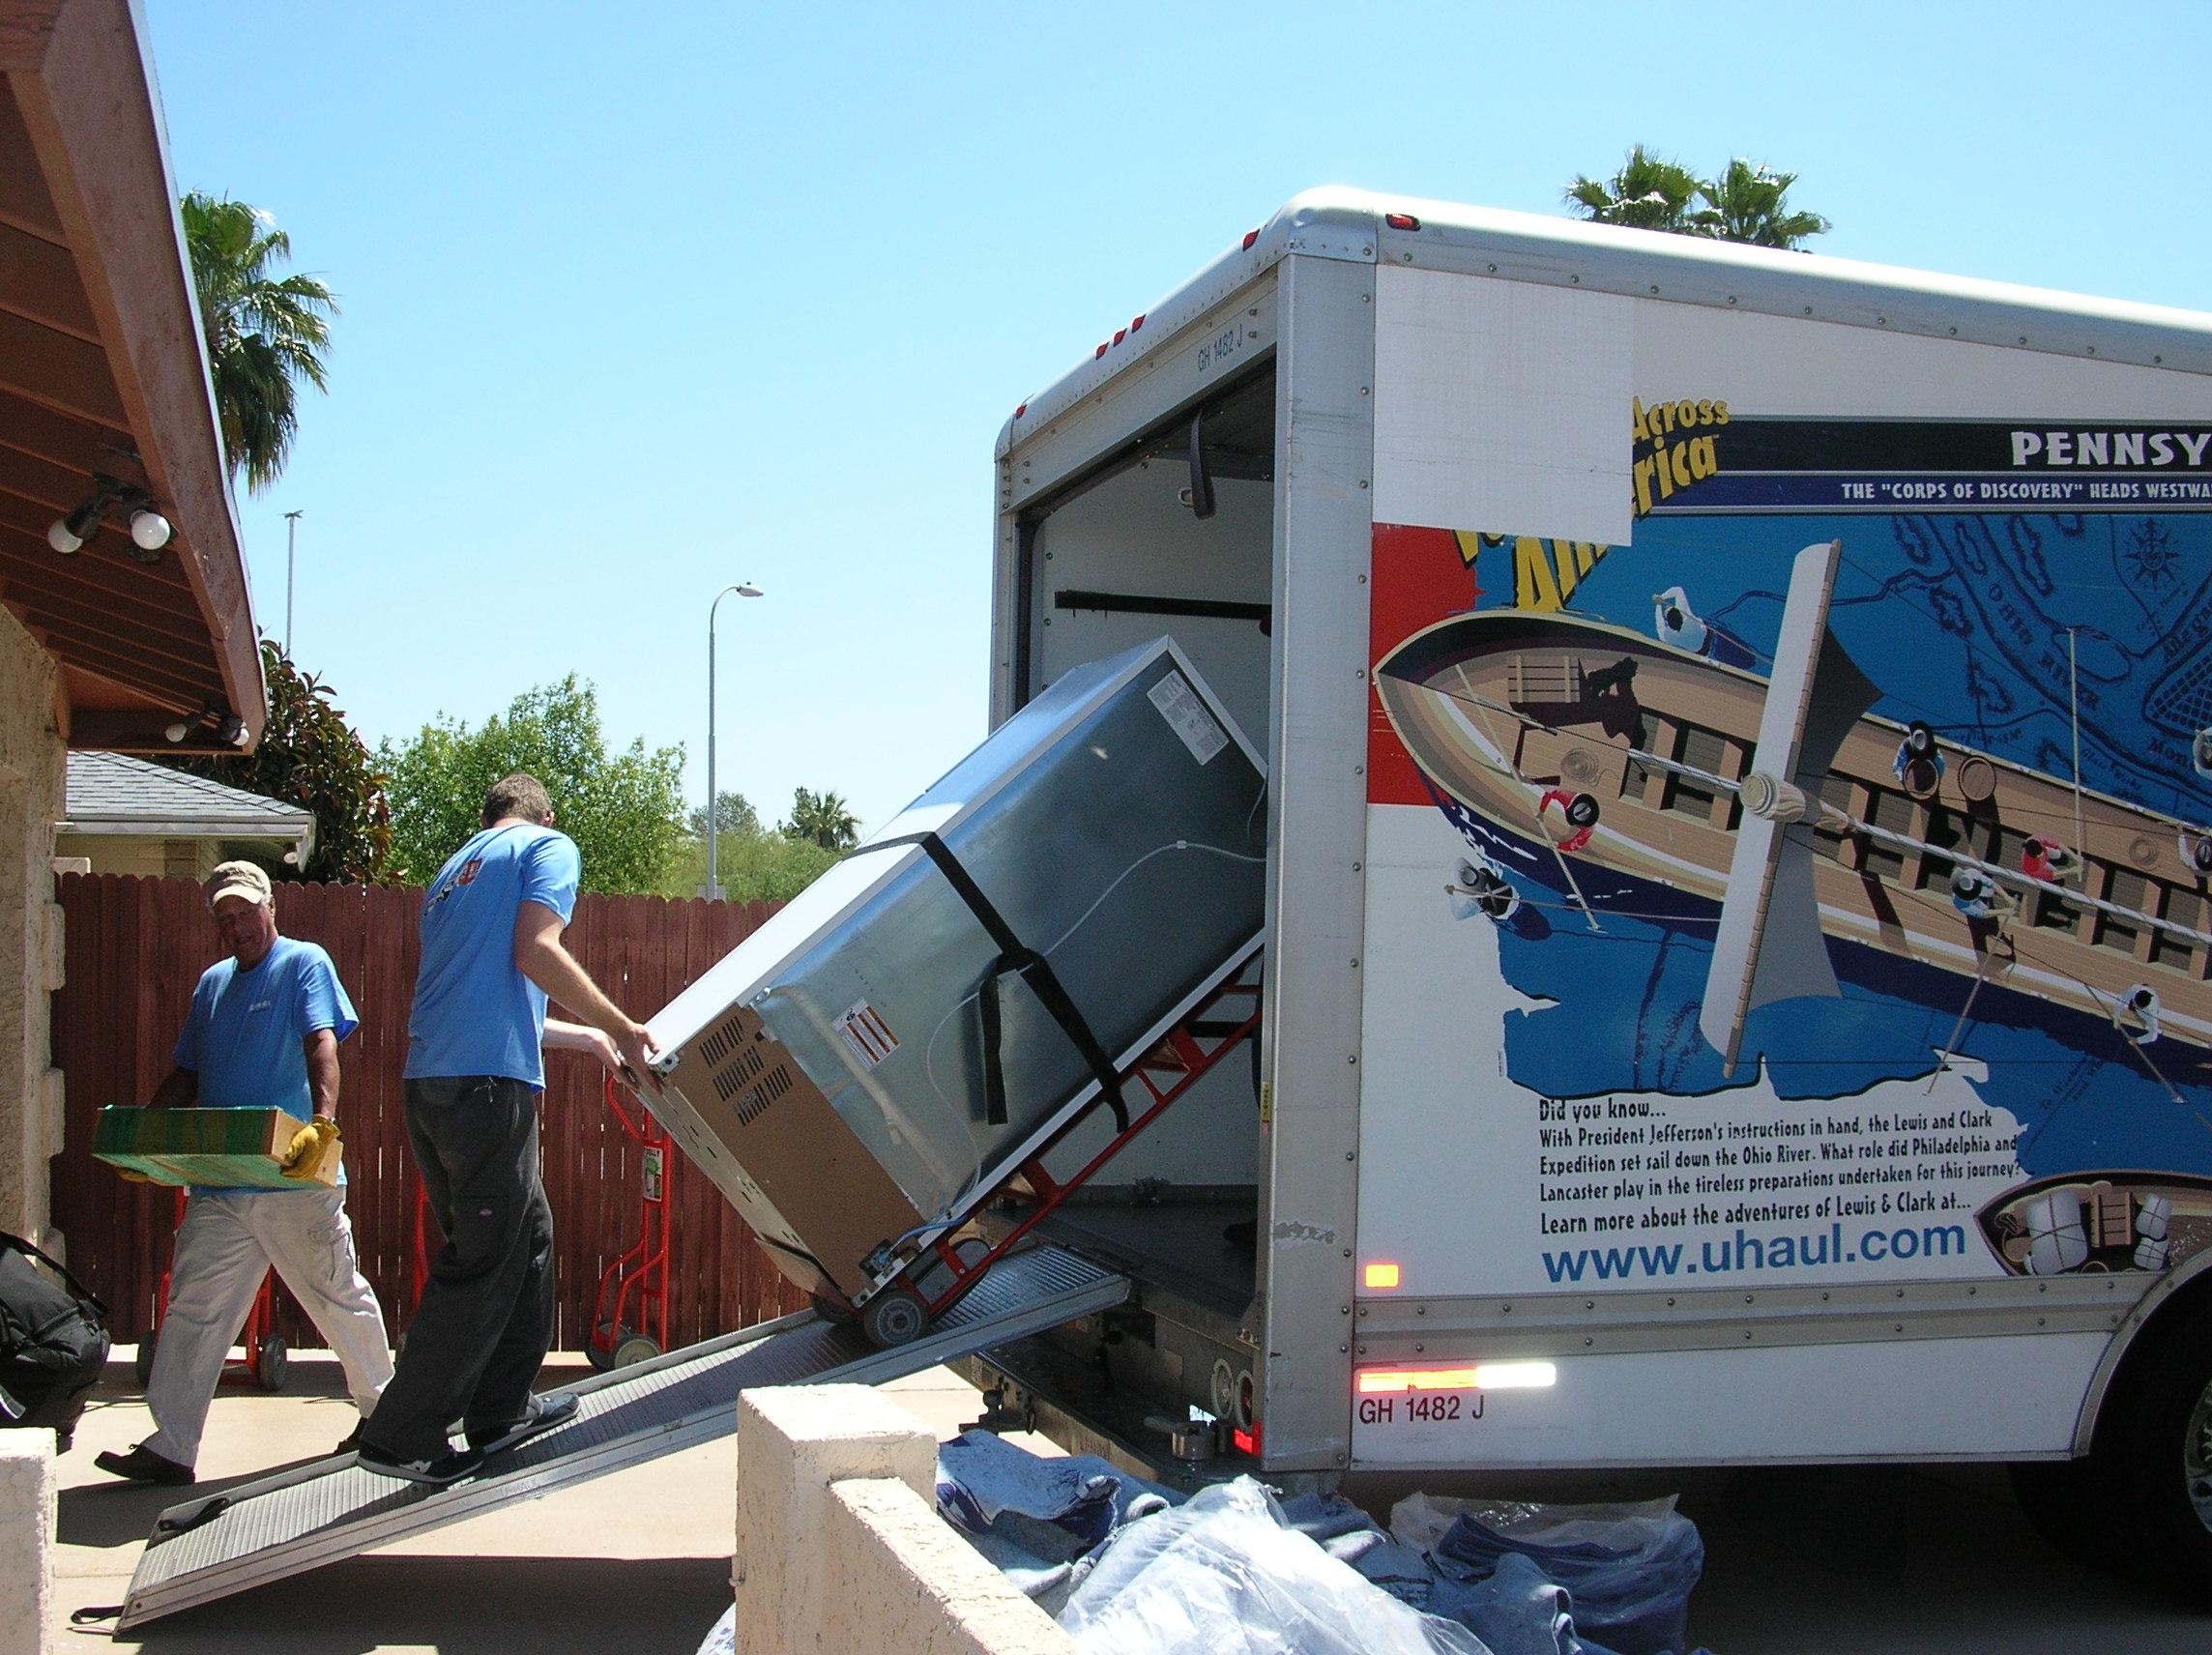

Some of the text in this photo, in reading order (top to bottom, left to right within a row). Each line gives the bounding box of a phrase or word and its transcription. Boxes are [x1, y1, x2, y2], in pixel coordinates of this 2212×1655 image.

[1198, 324, 1242, 372] GH 1482 J
[1631, 395, 1730, 446] Across
[2010, 431, 2212, 466] PENNSY
[1631, 435, 1718, 516] rica
[1841, 482, 1876, 499] THE
[1881, 482, 1947, 499] "CORPS
[1953, 482, 1974, 499] OF
[1980, 482, 2082, 499] DISCOVERY"
[2089, 482, 2139, 499] HEADS
[1539, 1097, 1666, 1123] Did you know...
[1539, 1110, 1992, 1147] With President Jefferson's instructions in hand, the Lewis and Clark
[1540, 1134, 2018, 1176] Expedition set sail down the Ohio River. What role did Philadelphia and
[1540, 1159, 2022, 1202] Lancaster play in the tireless preparations undertaken for this journey?
[1541, 1190, 1970, 1234] Learn more about the adventures of Lewis & Clark at...
[1541, 1223, 1966, 1284] www.uhaul.com
[1358, 1394, 1484, 1424] GH 1482 J
